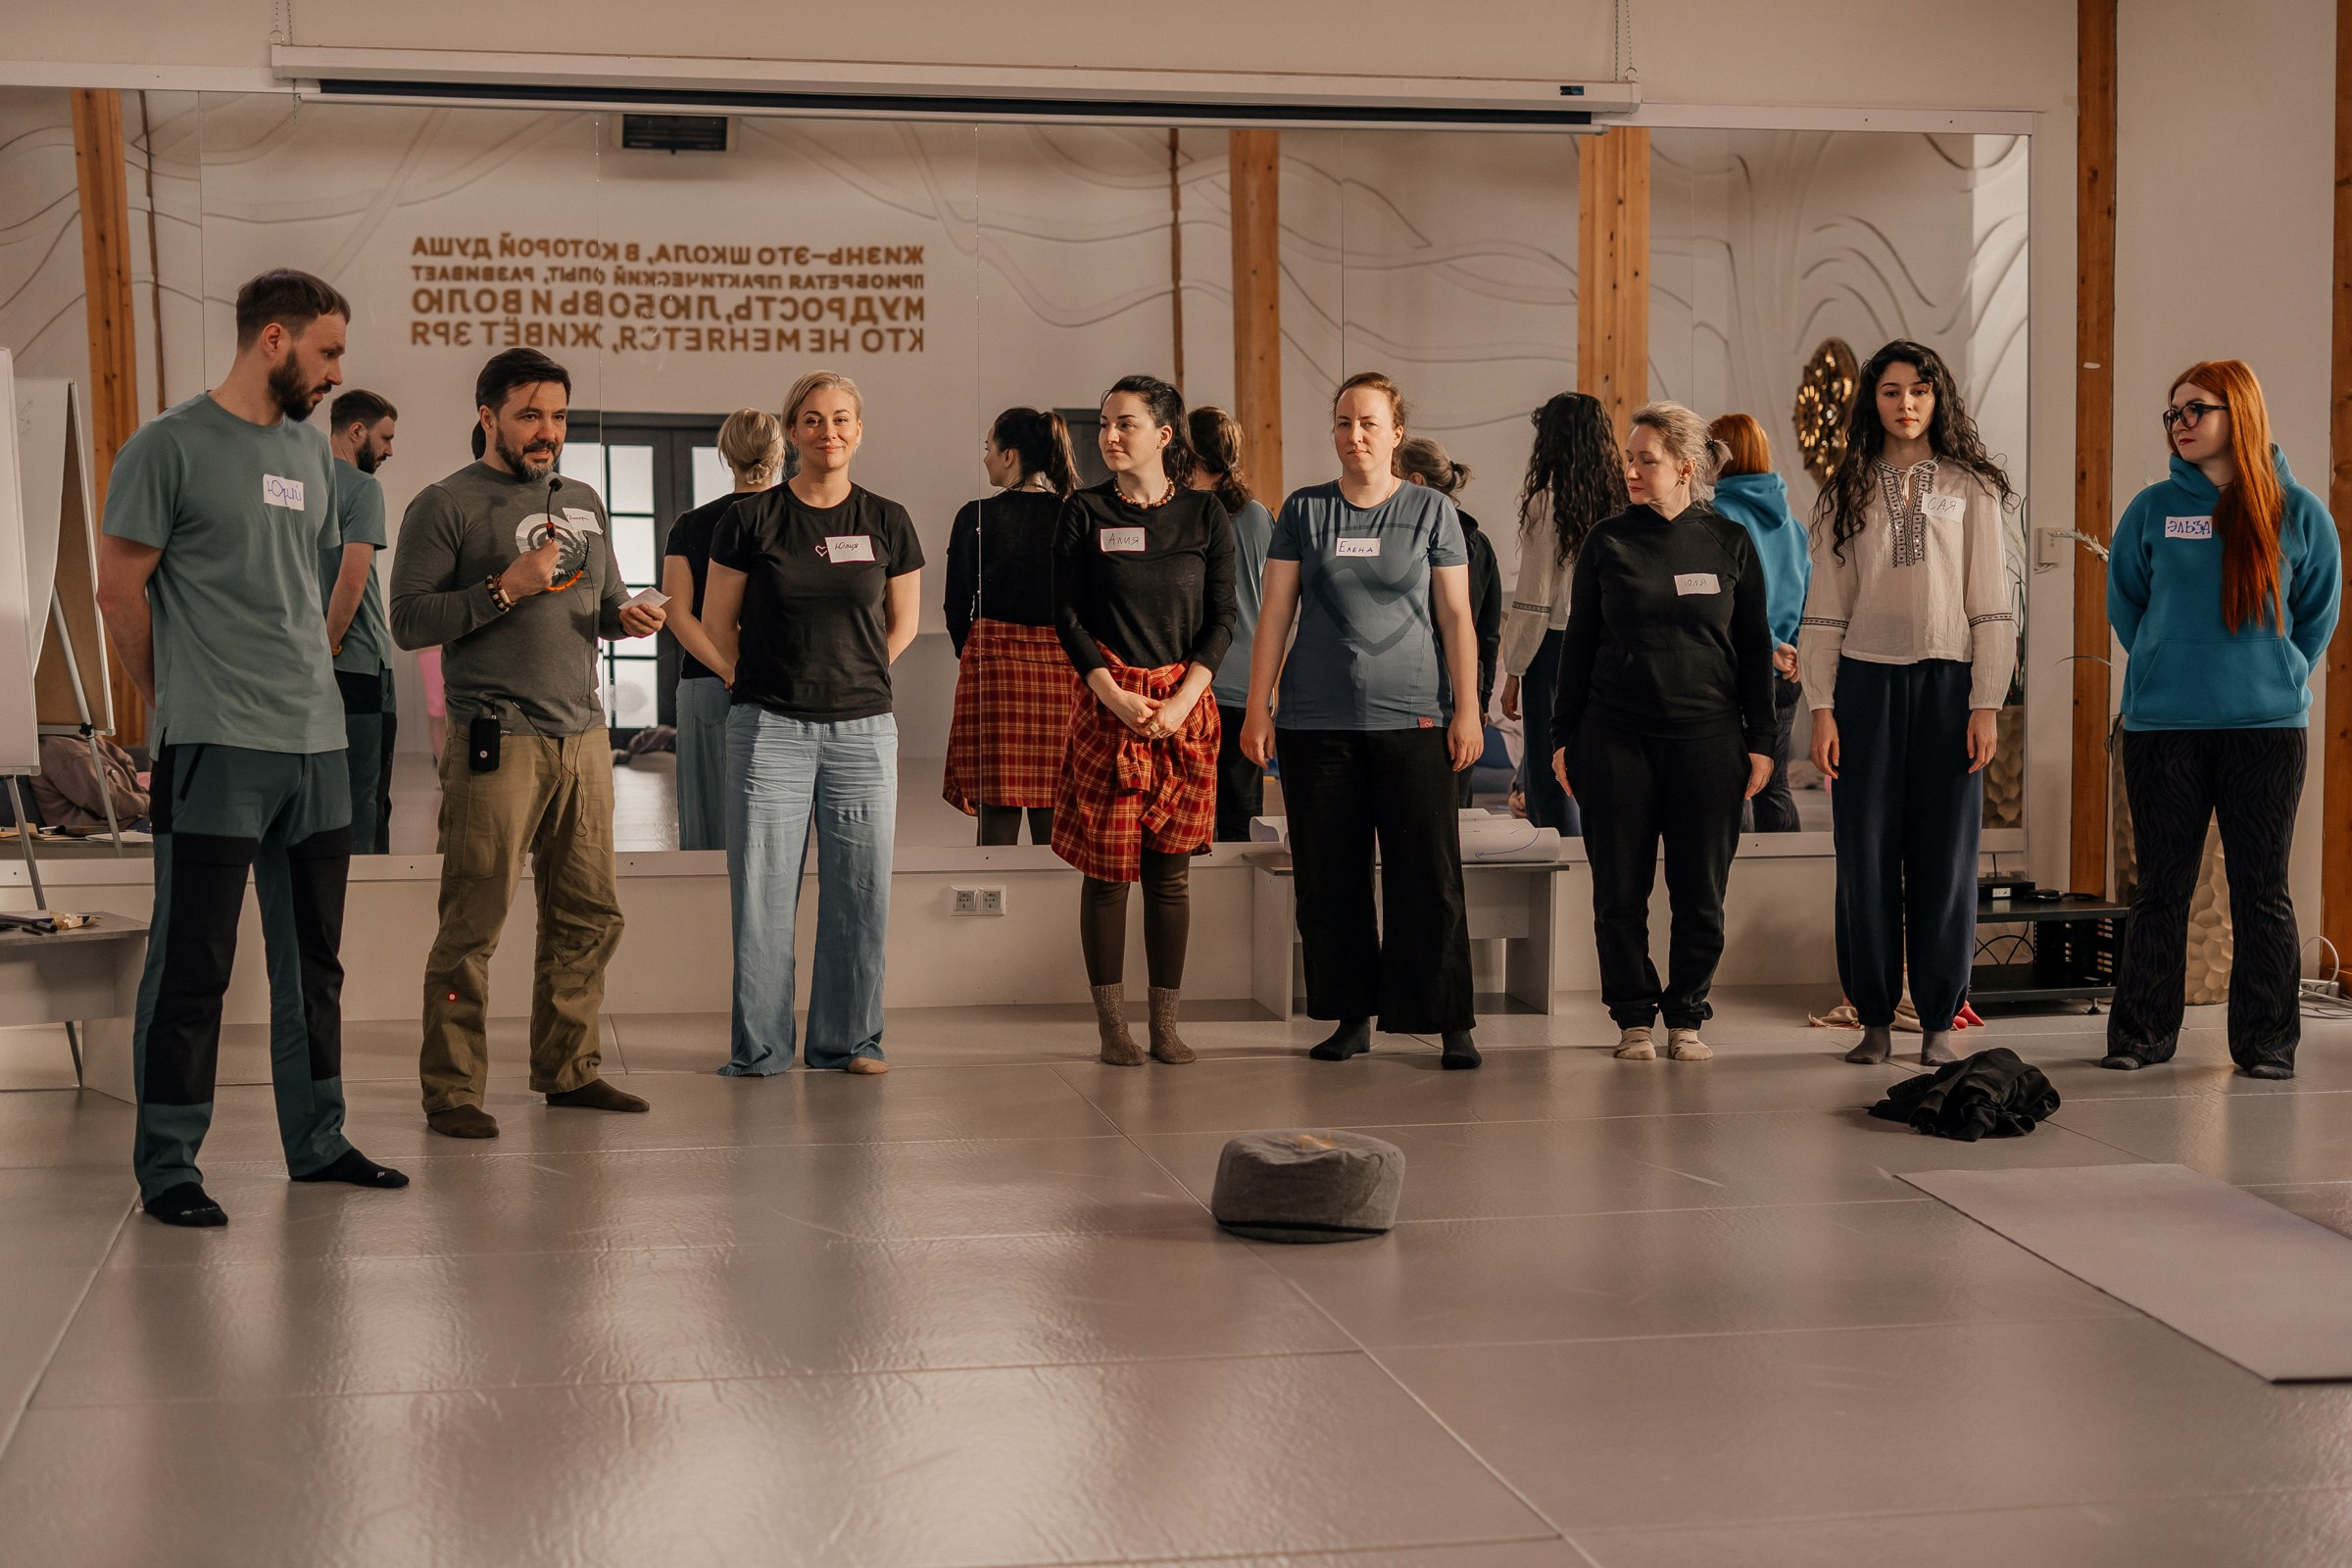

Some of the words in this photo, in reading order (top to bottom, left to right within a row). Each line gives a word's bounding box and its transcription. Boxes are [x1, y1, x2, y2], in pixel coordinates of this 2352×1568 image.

[267, 479, 302, 506] Юрий
[1928, 497, 1957, 513] САЯ
[2167, 520, 2211, 535] ЭЛЬЗА
[1107, 532, 1139, 546] Алия
